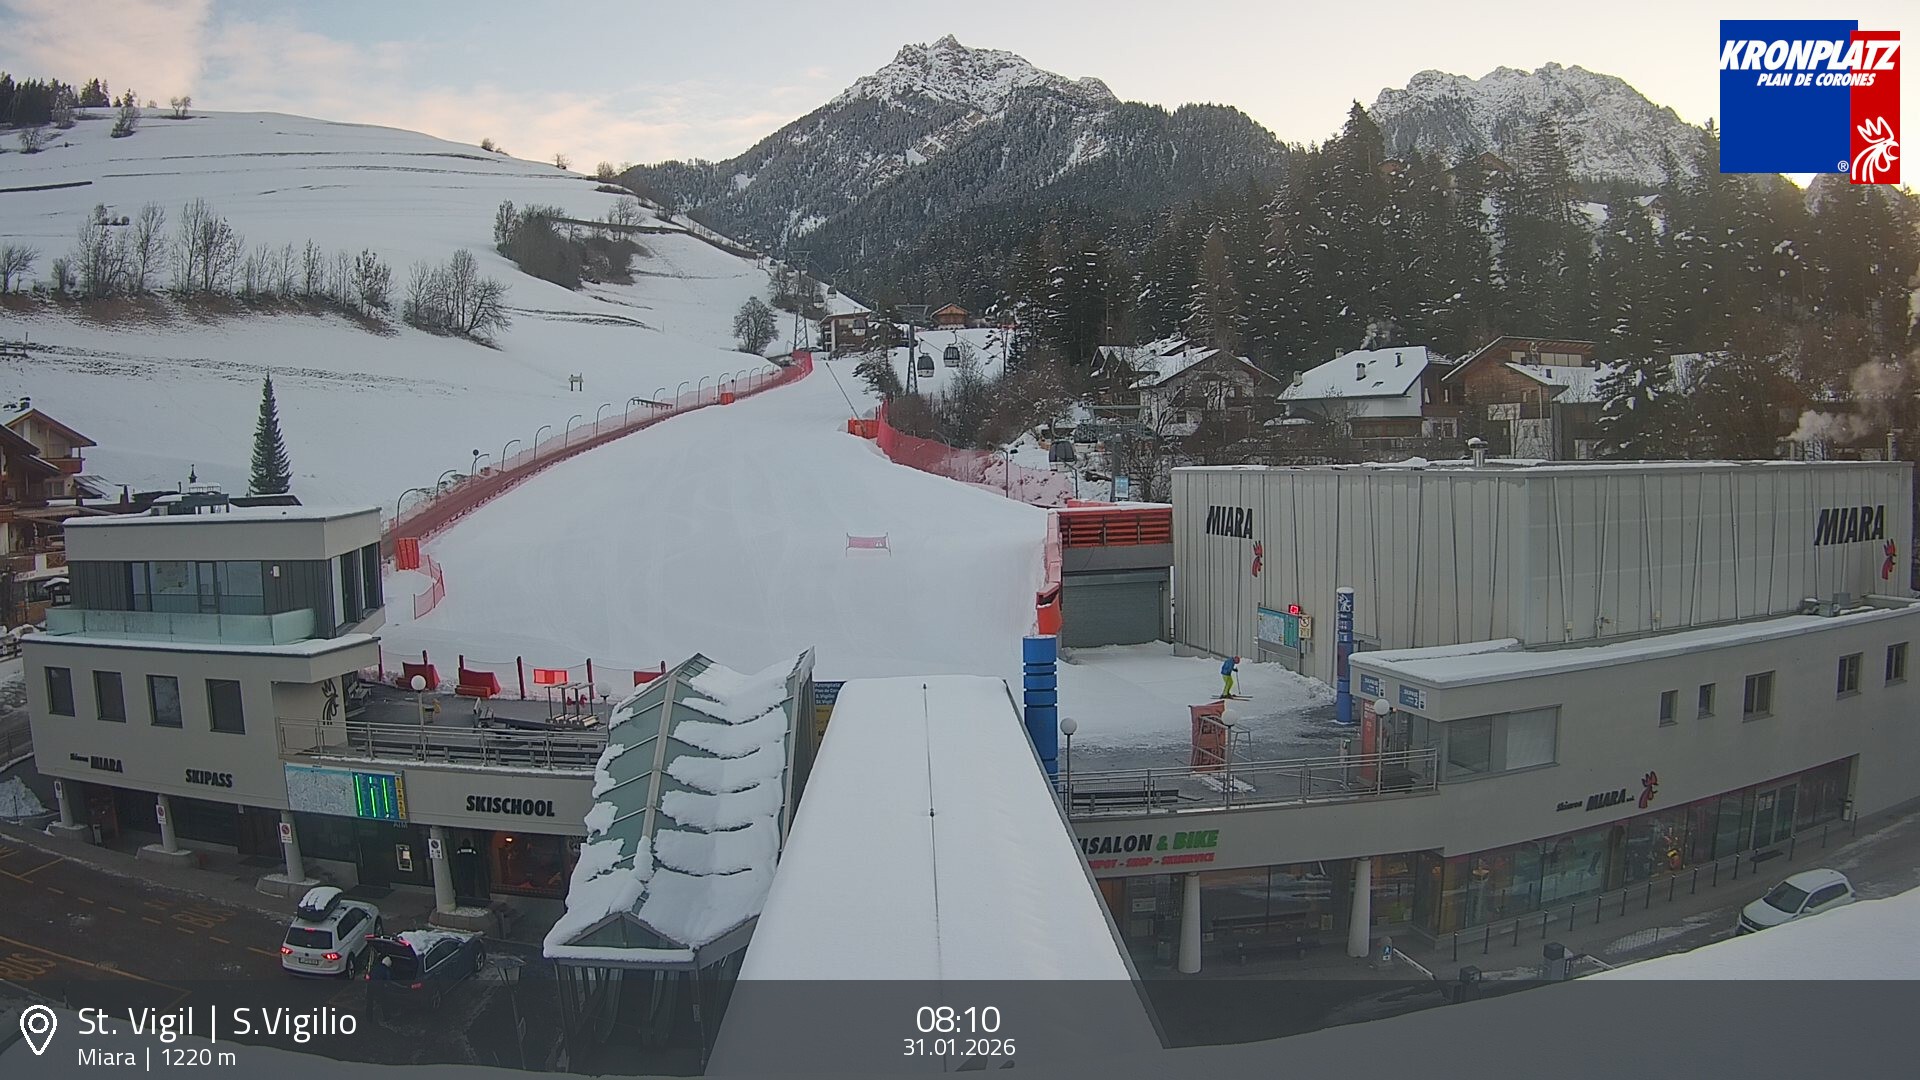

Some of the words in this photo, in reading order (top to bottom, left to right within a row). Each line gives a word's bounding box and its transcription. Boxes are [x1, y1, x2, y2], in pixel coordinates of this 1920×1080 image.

[1206, 505, 1253, 540] MIARA
[1814, 505, 1884, 546] MIARA
[91, 756, 123, 773] MIARA
[186, 769, 233, 788] SKIPASS
[466, 795, 555, 817] SKISCHOOL
[1586, 789, 1626, 811] MIARA
[1077, 834, 1153, 855] ISALON
[1156, 836, 1168, 851] &
[1173, 830, 1219, 850] BIKE
